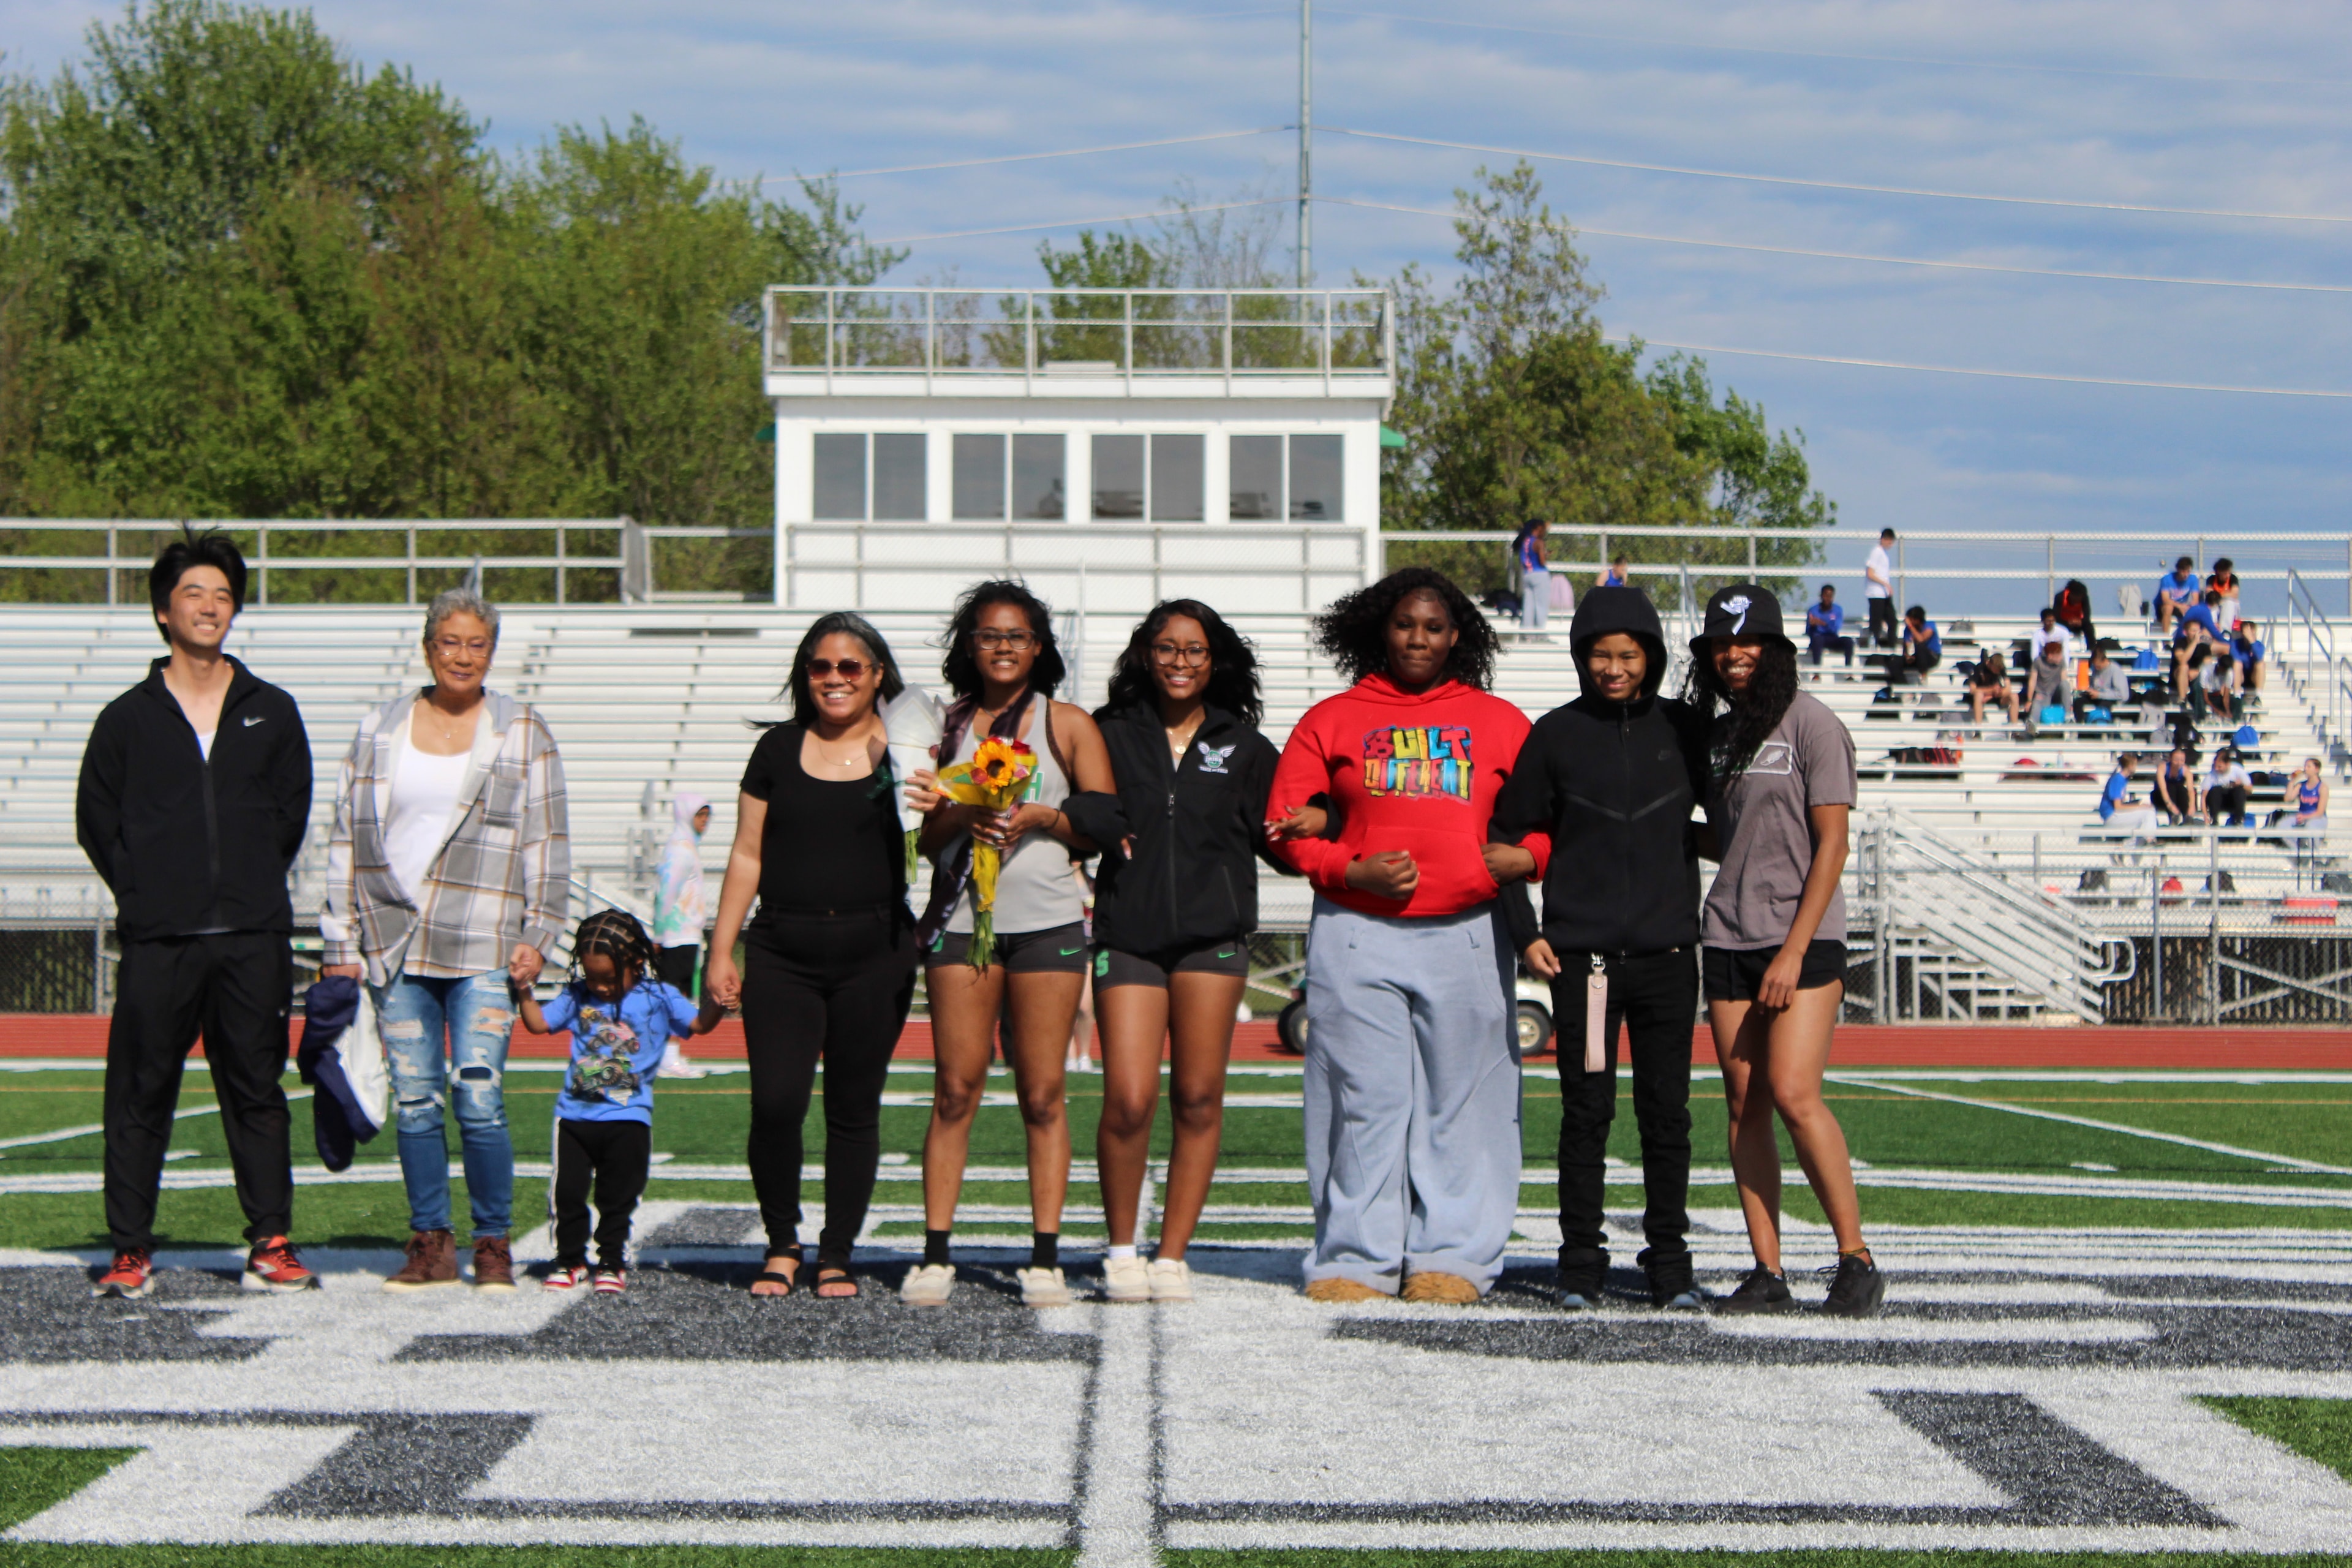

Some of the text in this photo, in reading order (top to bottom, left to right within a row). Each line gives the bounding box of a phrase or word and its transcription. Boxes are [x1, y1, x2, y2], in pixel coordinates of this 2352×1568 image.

[1364, 728, 1469, 761] BUILT
[1365, 758, 1471, 800] DIFFERENT
[1096, 950, 1109, 978] S
